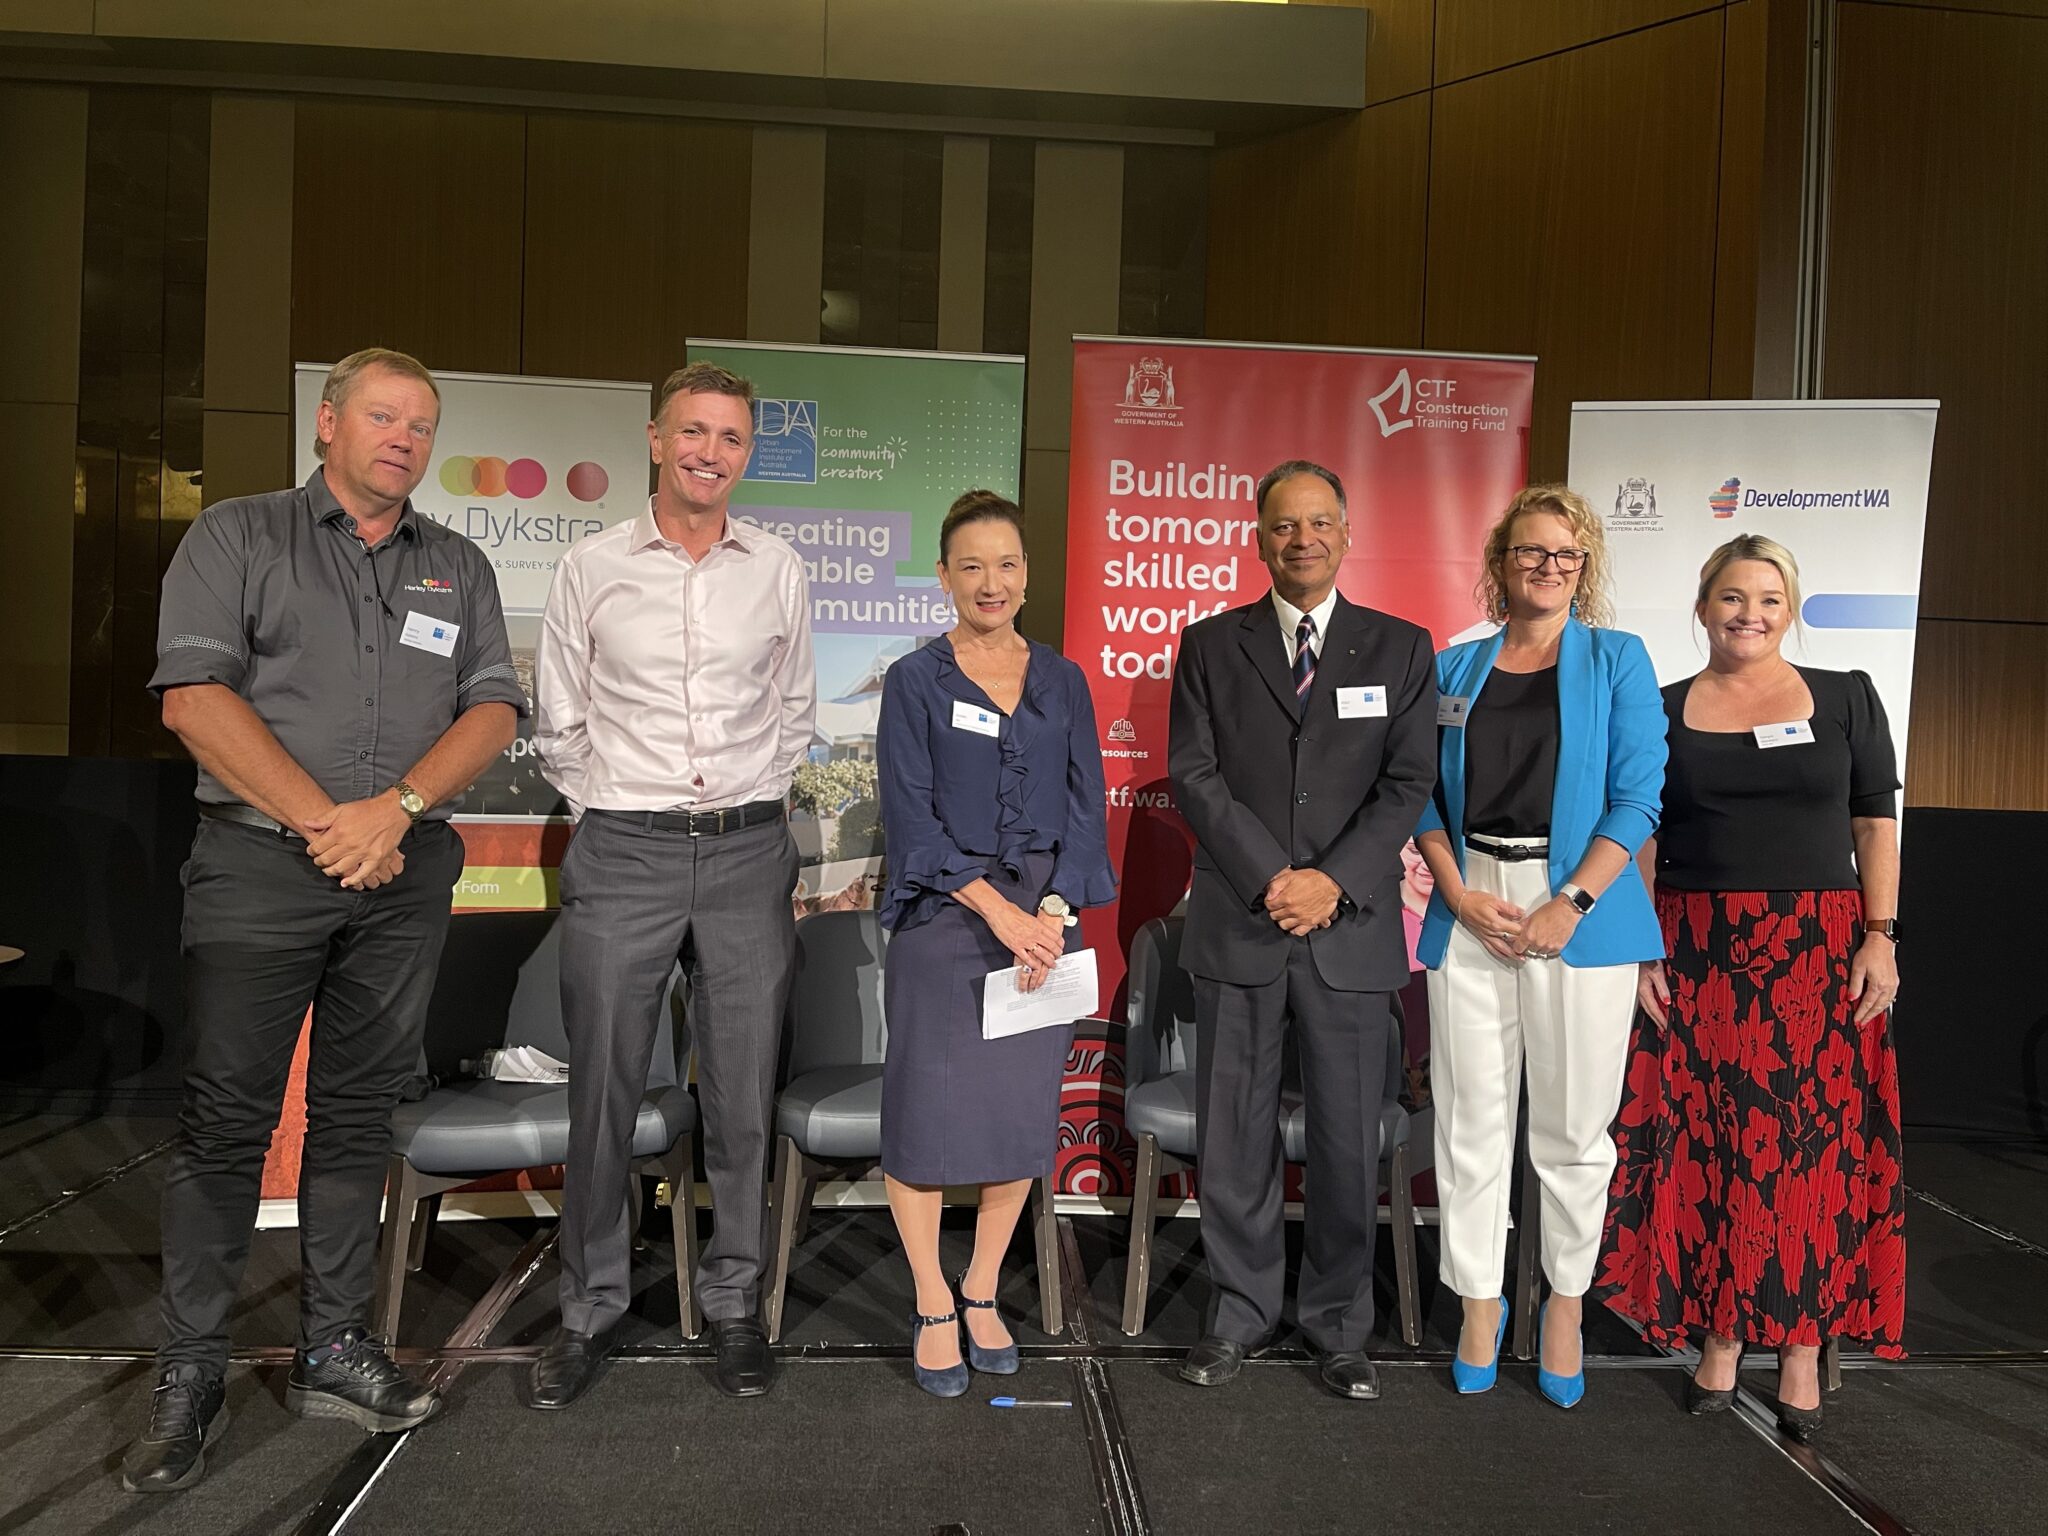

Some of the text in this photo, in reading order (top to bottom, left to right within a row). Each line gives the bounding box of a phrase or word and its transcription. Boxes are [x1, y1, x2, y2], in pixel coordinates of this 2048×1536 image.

[1415, 378, 1457, 399] CTF
[1121, 410, 1167, 418] GOVERNMENT
[1415, 400, 1509, 417] Construction
[823, 426, 868, 439] For the
[1414, 415, 1506, 433] Training Fund
[821, 444, 896, 469] community
[820, 464, 884, 481] creators
[1109, 459, 1264, 501] Buildin
[1743, 488, 1891, 511] DevelopmentWA
[466, 506, 604, 548] Dykstra
[1105, 508, 1259, 547] tomorr
[494, 560, 502, 568] &
[505, 560, 544, 570] SURVEY
[804, 555, 875, 585] able
[1103, 551, 1238, 592] skilled
[404, 585, 426, 593] Harley
[808, 594, 958, 625] munitie
[1100, 748, 1149, 759] esources
[461, 880, 500, 894] Form
